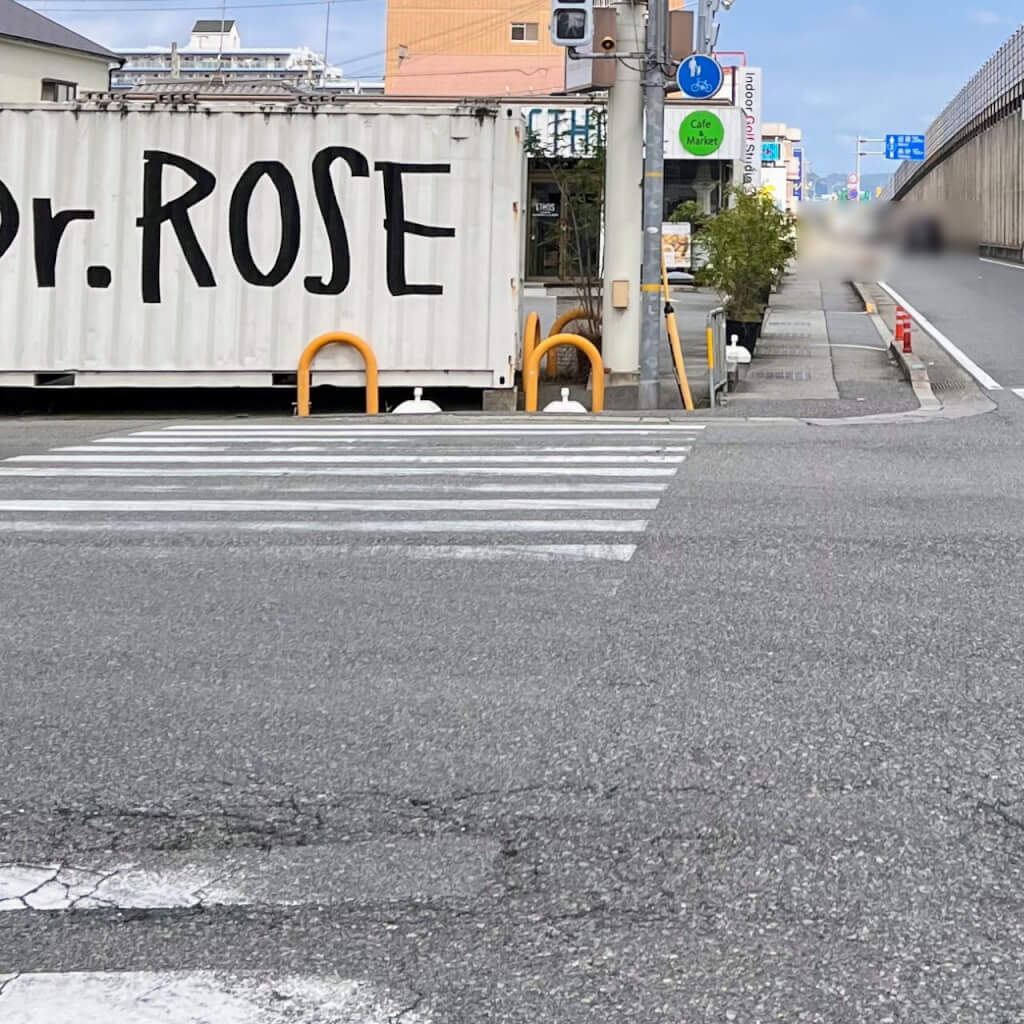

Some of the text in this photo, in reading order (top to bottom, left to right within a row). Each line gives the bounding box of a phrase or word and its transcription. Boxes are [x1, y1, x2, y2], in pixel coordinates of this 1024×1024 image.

[744, 72, 757, 112] Indoor
[690, 119, 712, 129] Cafe
[745, 115, 756, 141] Golf
[686, 135, 719, 146] Market
[136, 146, 456, 304] ROSE
